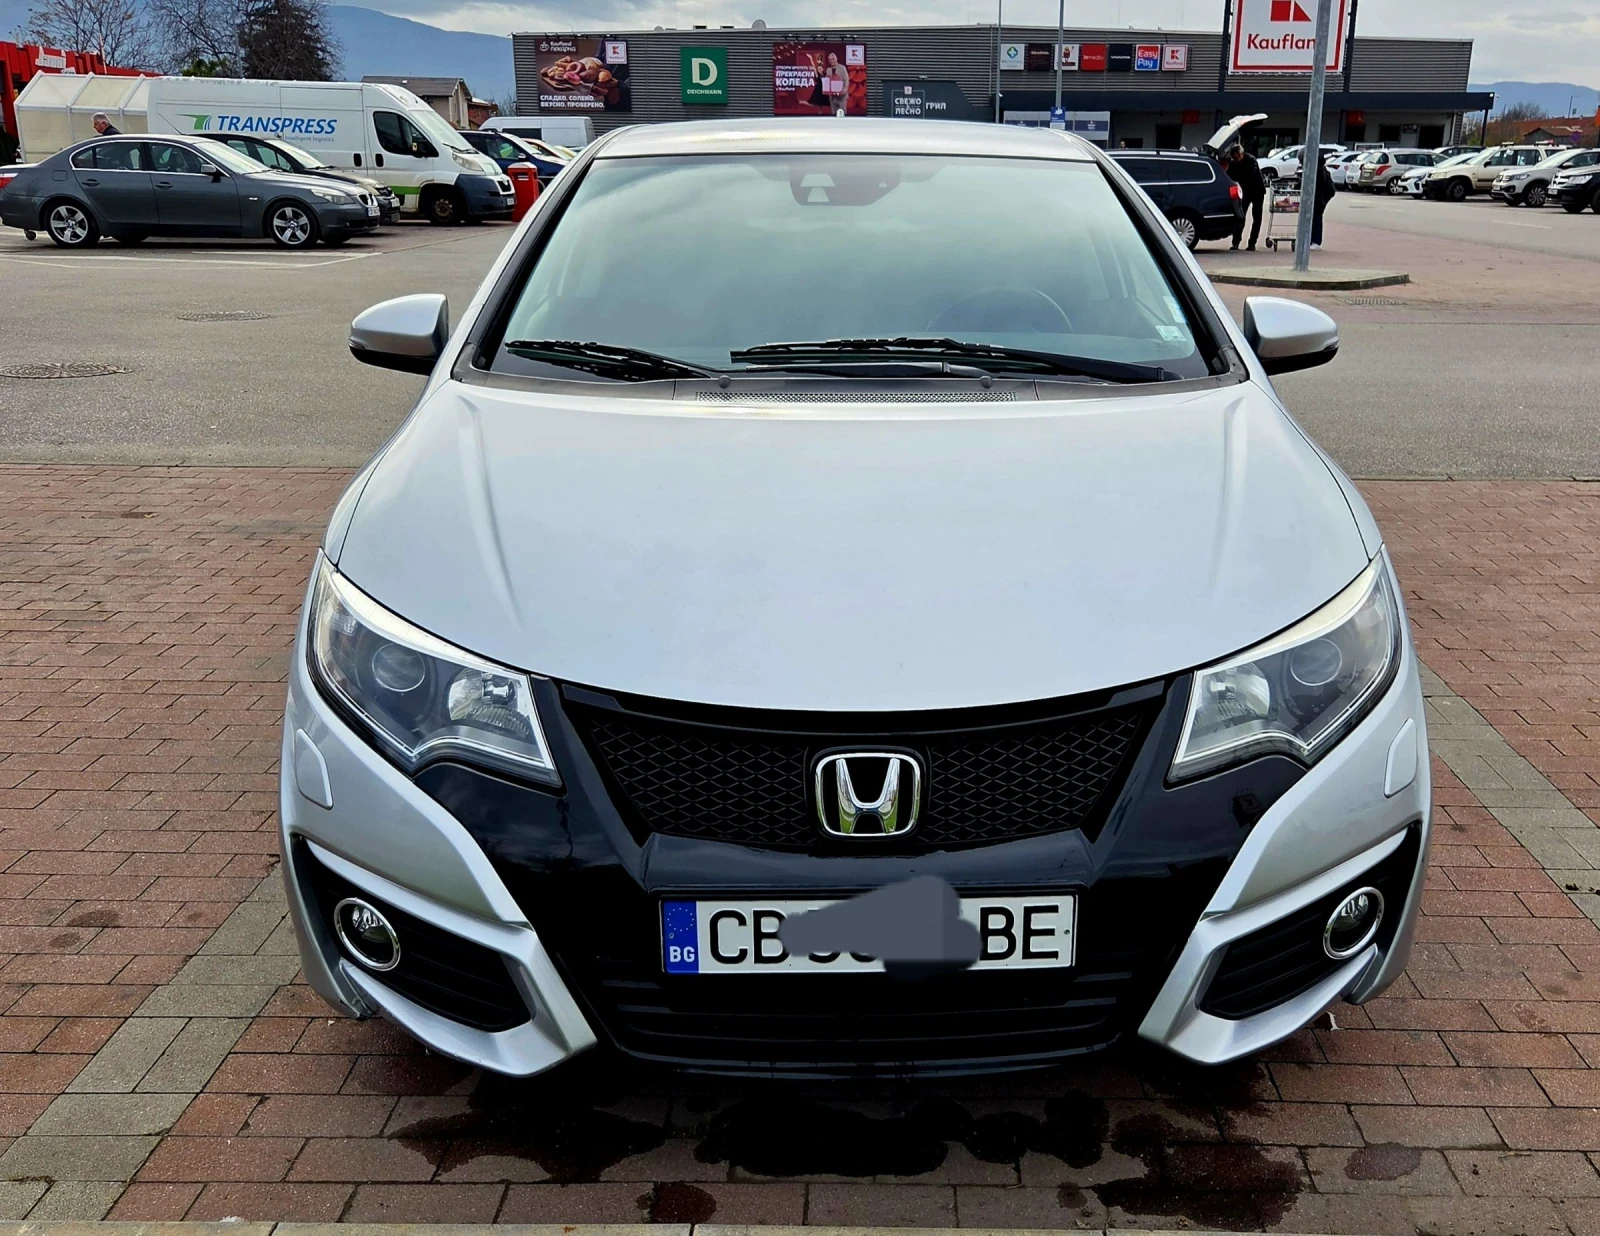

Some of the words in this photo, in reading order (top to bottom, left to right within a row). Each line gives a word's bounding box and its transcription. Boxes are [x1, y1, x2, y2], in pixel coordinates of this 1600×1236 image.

[1247, 33, 1316, 50] Kauflan
[1138, 50, 1158, 59] Easy
[1137, 59, 1153, 68] Pay
[691, 58, 718, 86] D
[775, 70, 815, 78] ПРЕКРАСНА
[775, 78, 815, 88] КОЛЕДА
[894, 97, 922, 105] СВЕЖО
[925, 102, 947, 110] ГРИЛ
[895, 107, 922, 115] ЛЕСНО
[218, 115, 337, 134] TRANSPRESS
[979, 904, 1059, 961] BE
[669, 945, 696, 963] BG
